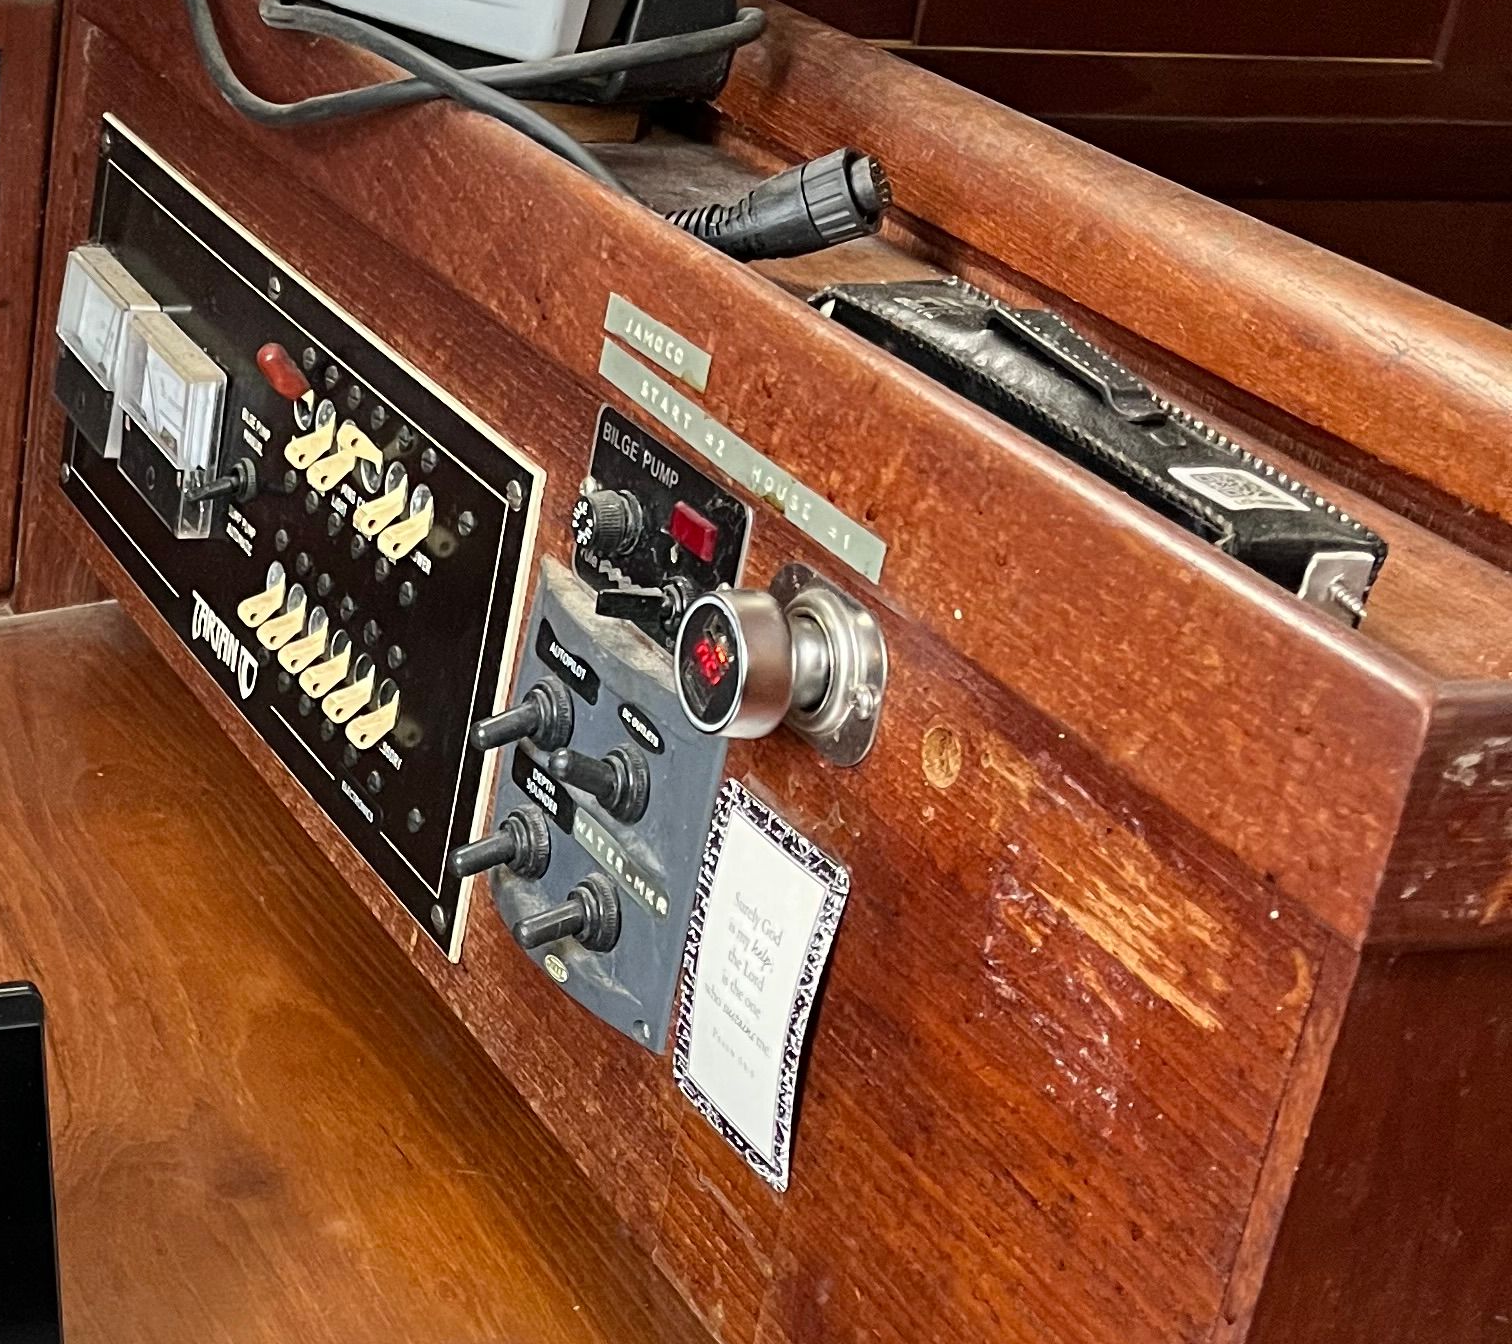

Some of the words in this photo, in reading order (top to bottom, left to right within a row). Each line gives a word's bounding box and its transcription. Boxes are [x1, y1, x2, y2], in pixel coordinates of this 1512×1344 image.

[602, 421, 640, 463] BILGE
[642, 449, 680, 490] PUMP
[640, 380, 693, 430] START
[750, 464, 812, 521] HOUSE
[191, 589, 240, 674] TARTAN
[548, 639, 589, 682] AUTOPILOT
[526, 777, 559, 817] SOUNDER
[531, 767, 557, 797] DEPTH
[735, 891, 760, 930] Surely
[762, 917, 783, 947] God
[744, 958, 765, 993] Lord
